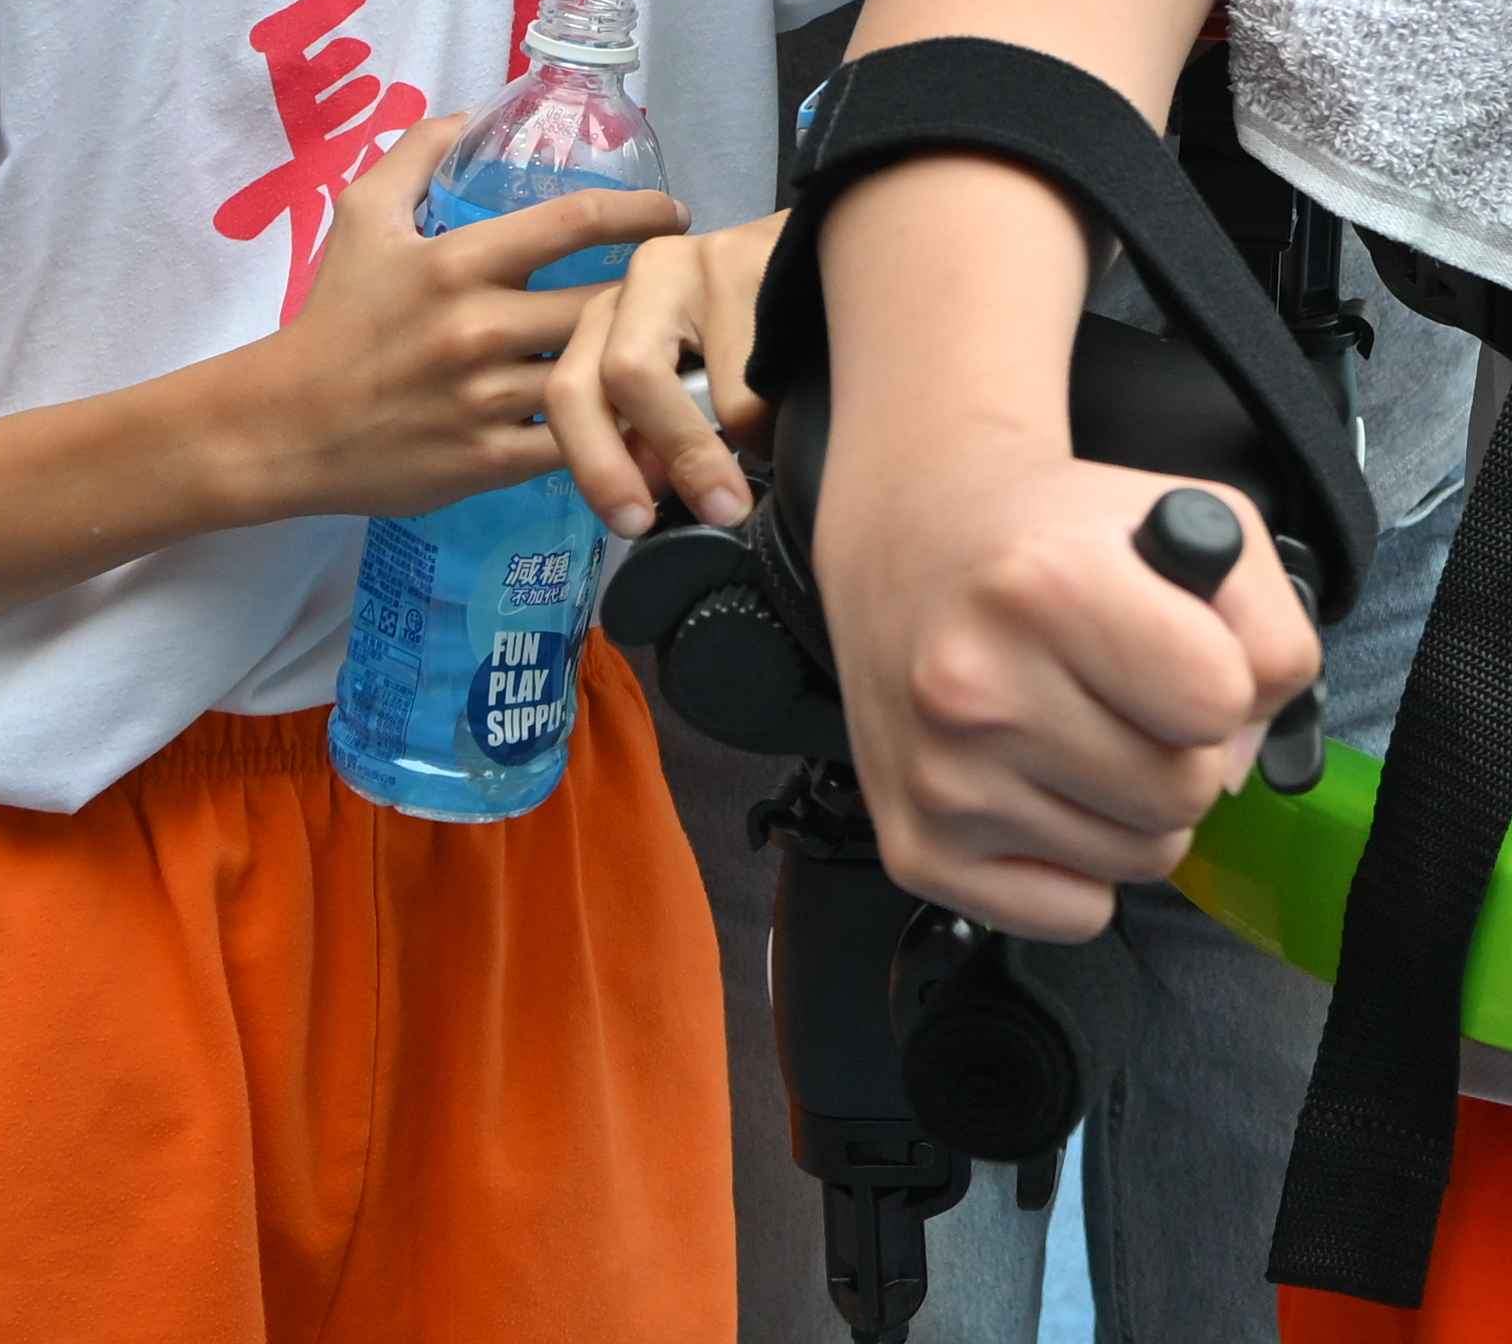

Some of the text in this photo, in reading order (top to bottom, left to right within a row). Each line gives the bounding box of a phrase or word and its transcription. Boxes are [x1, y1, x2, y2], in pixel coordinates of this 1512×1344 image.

[506, 553, 571, 588] 減糖
[491, 631, 541, 666] FUN
[488, 669, 549, 706] PLAY
